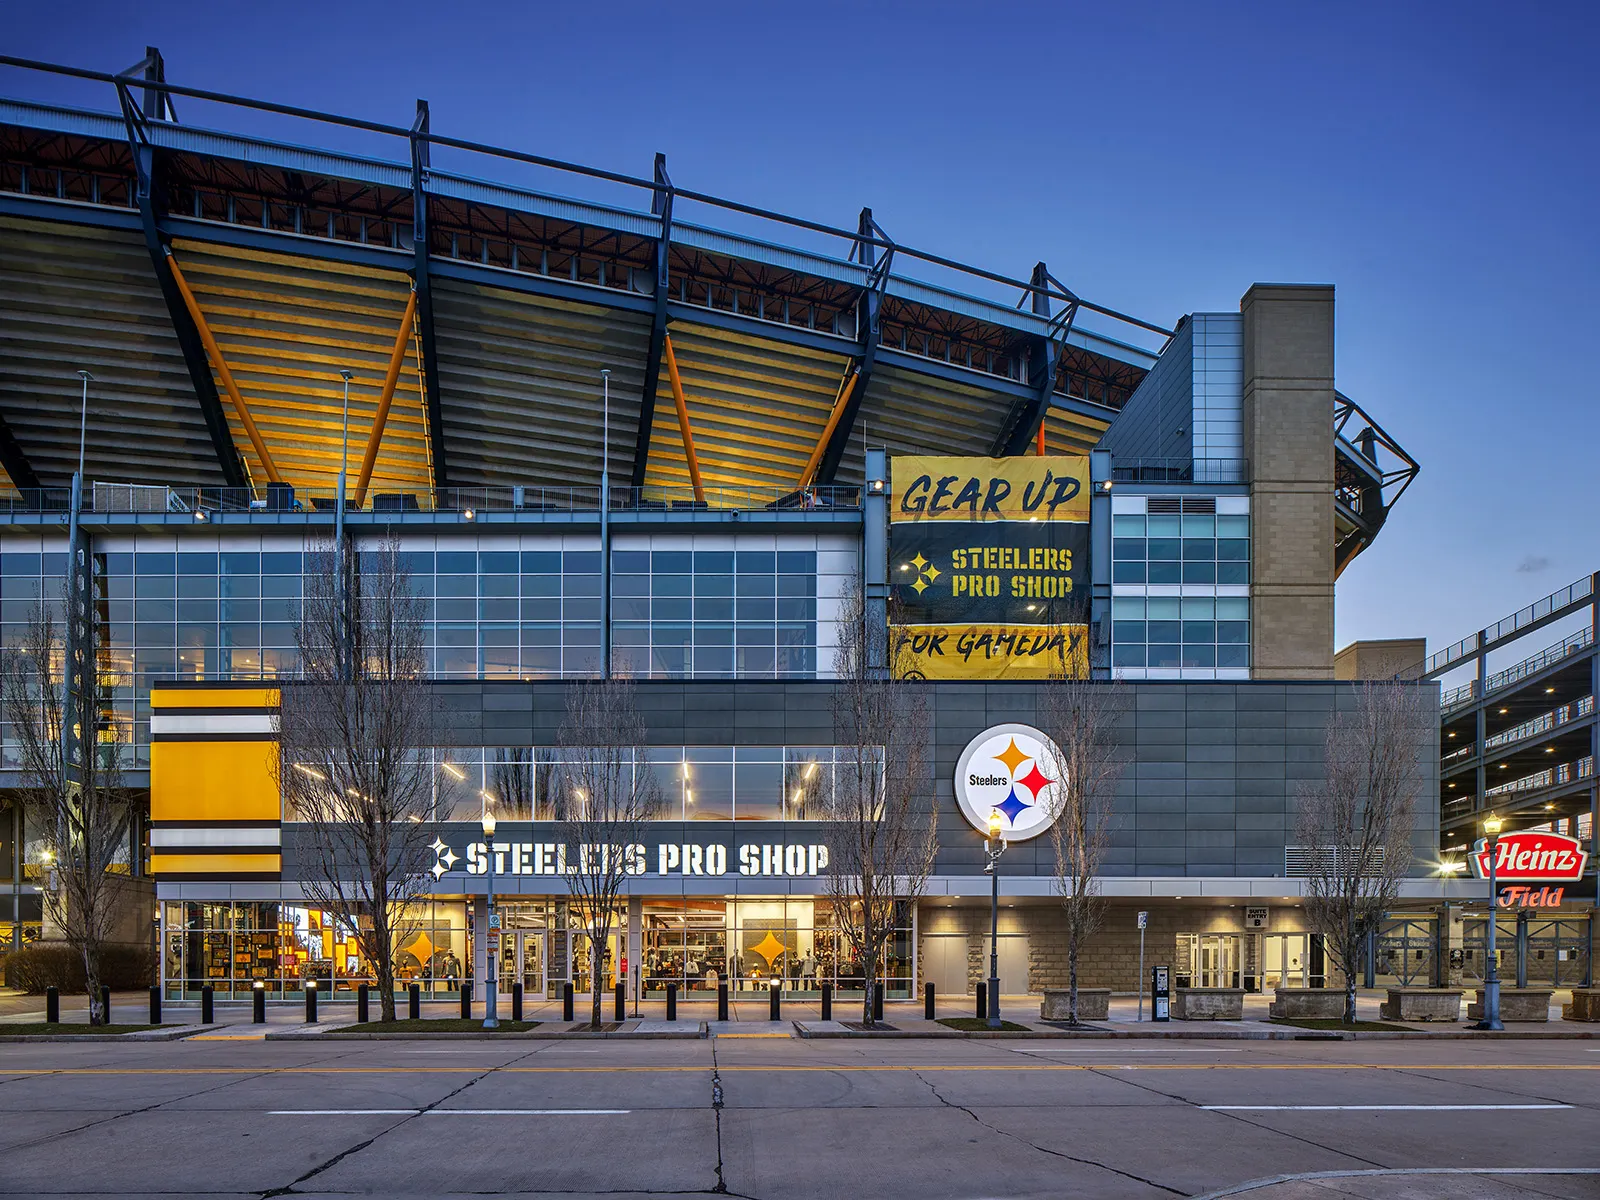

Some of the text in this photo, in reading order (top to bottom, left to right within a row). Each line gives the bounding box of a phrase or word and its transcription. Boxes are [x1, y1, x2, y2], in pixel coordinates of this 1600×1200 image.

[901, 469, 1081, 521] GEAR UP
[952, 547, 1073, 571] STEELERS
[952, 575, 1073, 598] PRO SHOP
[897, 627, 1084, 662] FOR GAMEDAY
[969, 774, 1008, 787] Steelers
[466, 843, 829, 876] STEELERS PRO SHOP
[1483, 842, 1577, 871] Heinz
[1498, 886, 1564, 907] Field
